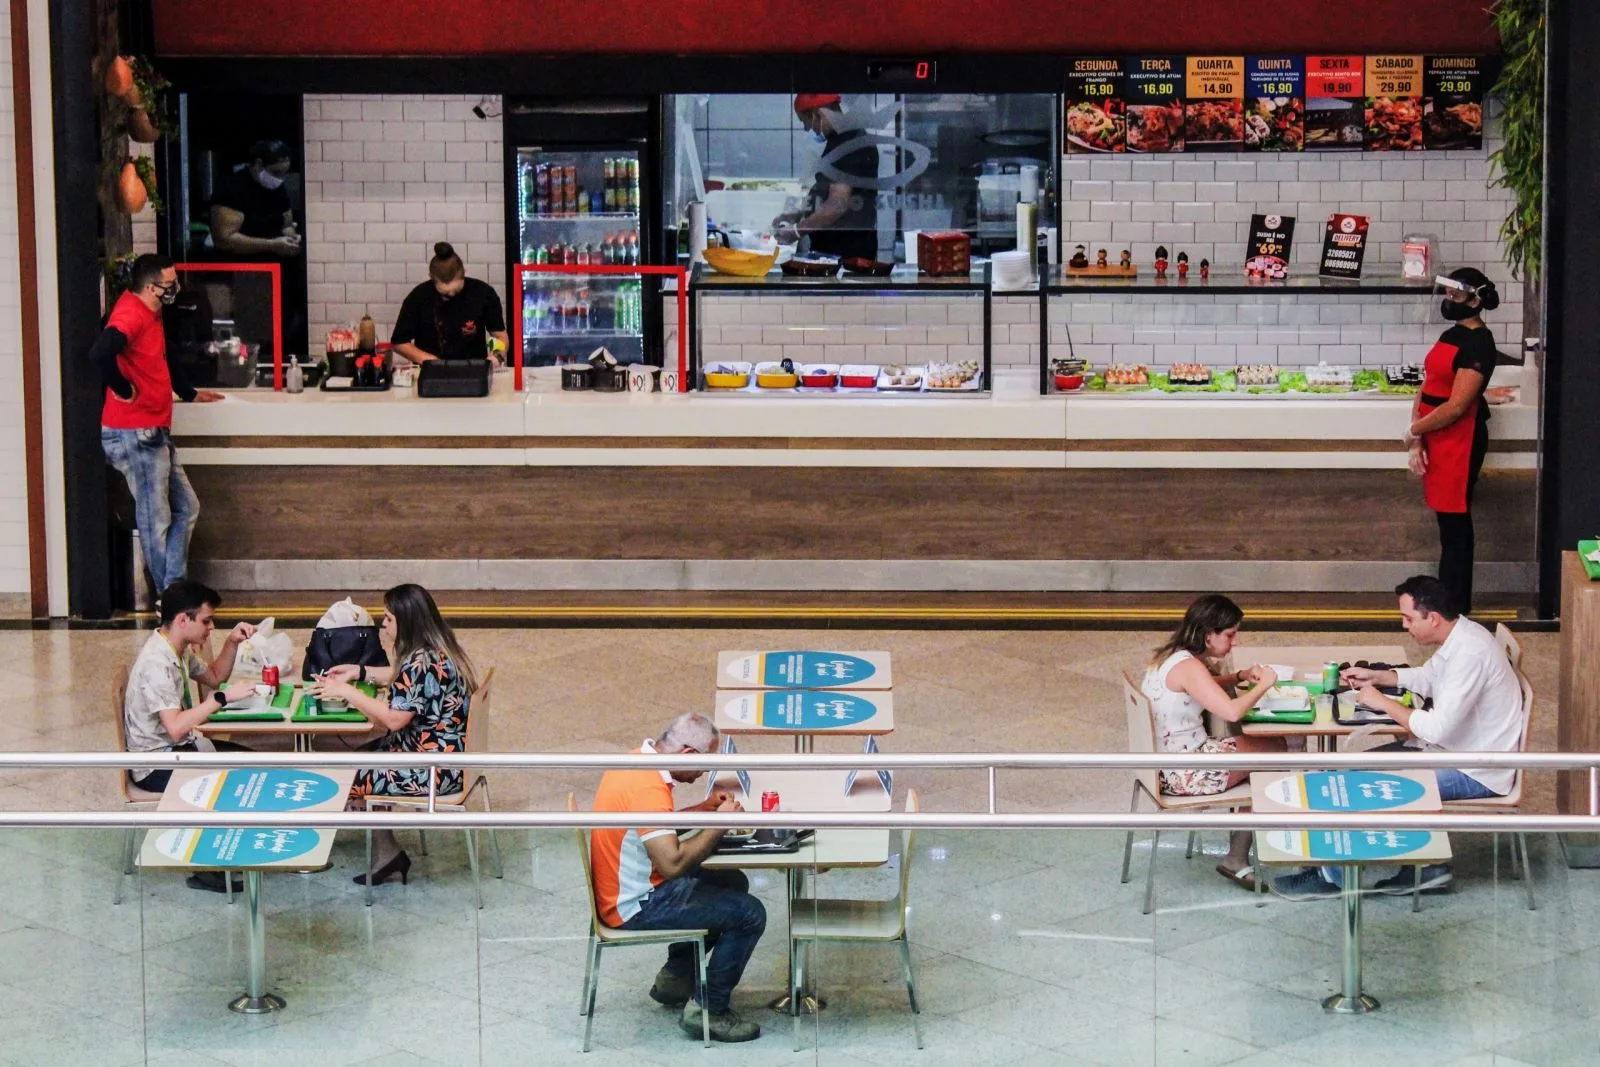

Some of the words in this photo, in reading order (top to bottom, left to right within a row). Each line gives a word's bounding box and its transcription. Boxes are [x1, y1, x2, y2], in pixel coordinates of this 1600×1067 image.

[1075, 60, 1118, 71] SEGUNDA
[1140, 60, 1171, 72] TERÇA
[1197, 60, 1233, 69] QUARTA
[1258, 60, 1291, 69] QUINTA
[1320, 59, 1350, 69] SEXTA
[1432, 58, 1476, 68] DOMINGO
[916, 62, 928, 78] 0
[1084, 84, 1113, 96] 15,90
[1144, 84, 1173, 95] 16,90
[1204, 84, 1232, 94] 14,90
[1263, 83, 1292, 94] 16,90
[1381, 82, 1411, 93] 29,90
[1440, 81, 1471, 93] 29,90
[1334, 234, 1360, 242] DELIVERY
